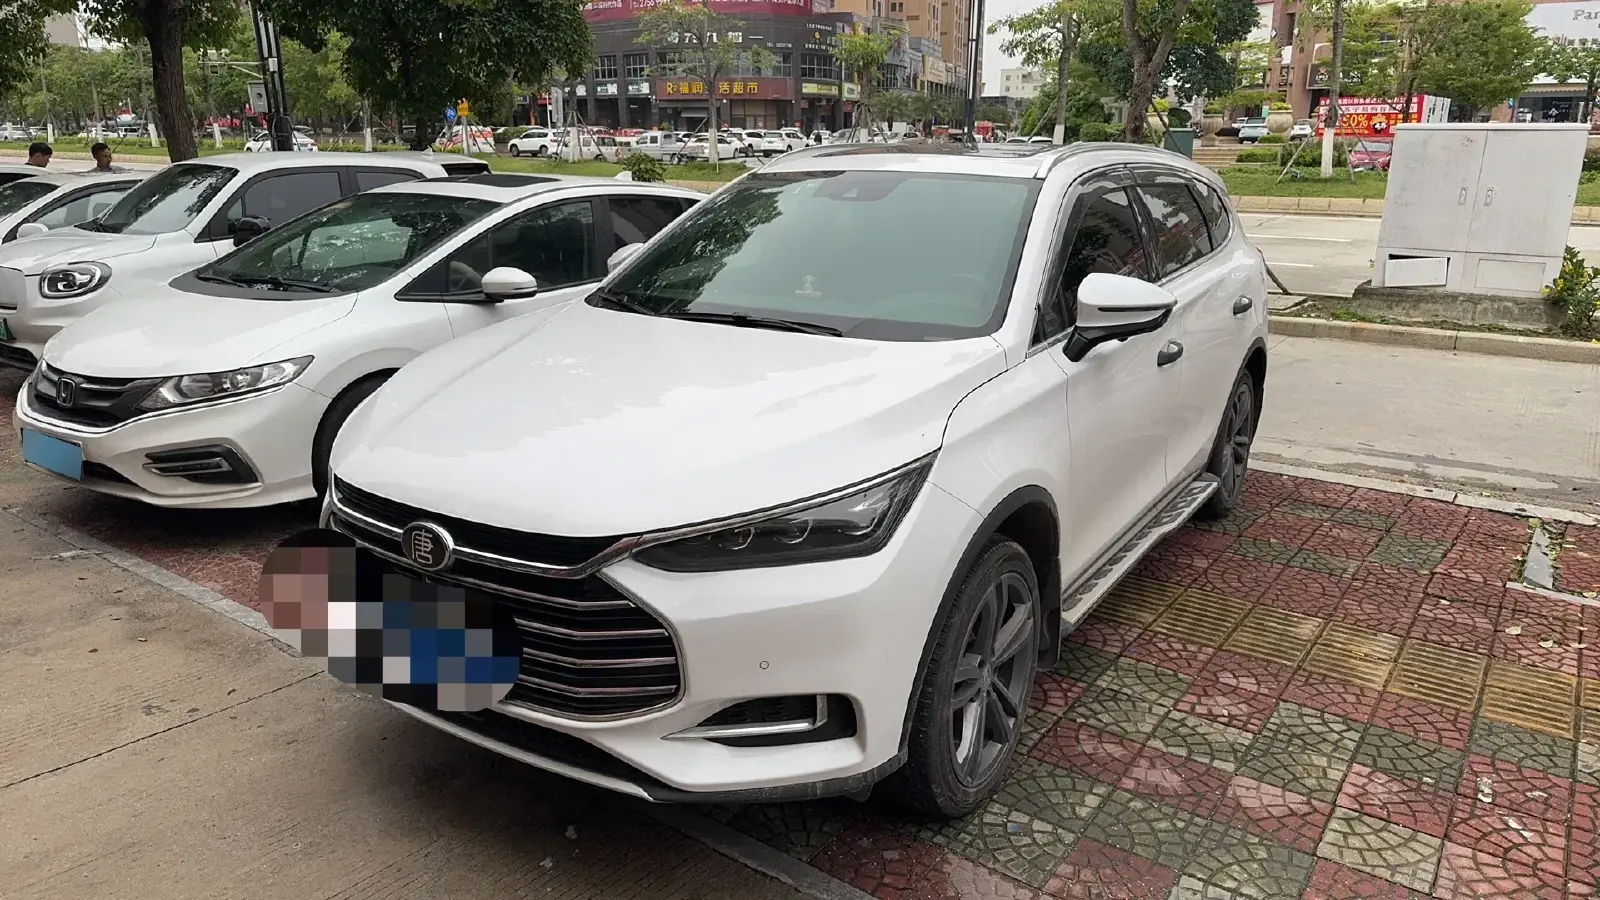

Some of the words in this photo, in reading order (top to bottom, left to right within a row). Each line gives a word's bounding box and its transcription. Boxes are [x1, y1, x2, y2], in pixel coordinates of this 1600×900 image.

[679, 81, 758, 95] 福润活超市
[412, 529, 434, 565] 唐
